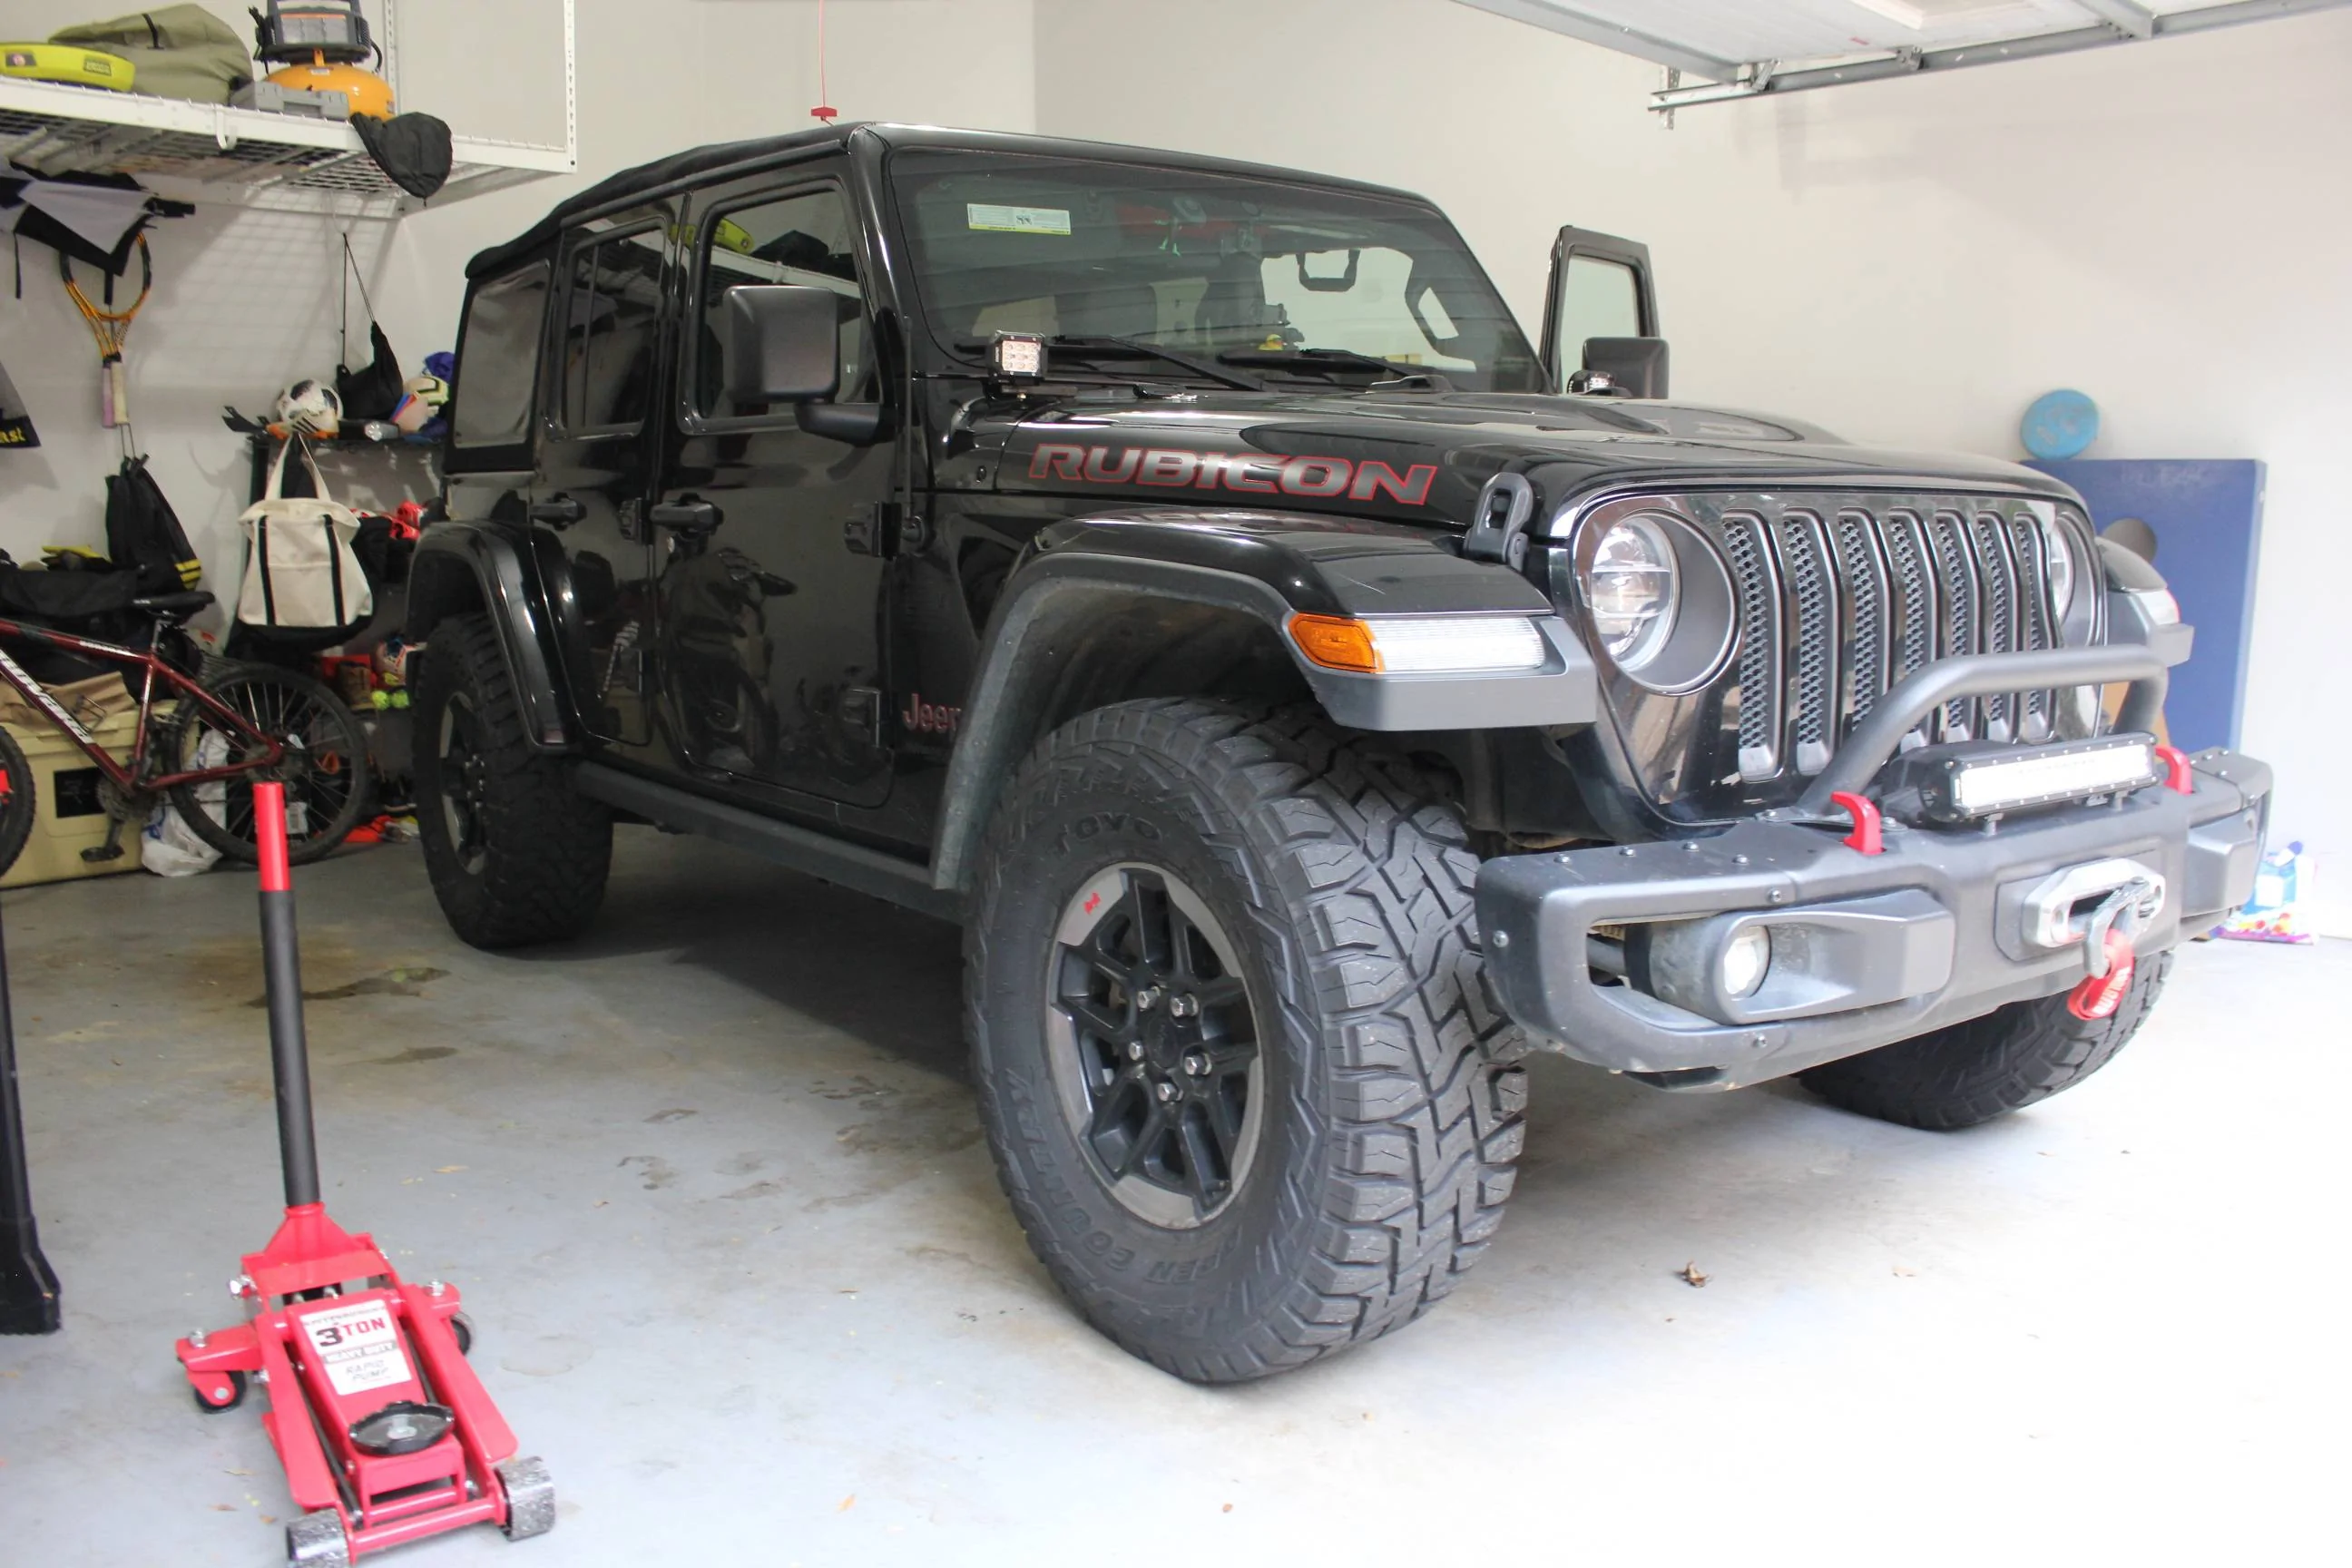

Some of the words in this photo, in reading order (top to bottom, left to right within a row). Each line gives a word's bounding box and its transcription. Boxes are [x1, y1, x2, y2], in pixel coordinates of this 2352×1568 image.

[1027, 443, 1438, 505] RUBICON
[315, 1326, 343, 1348] 3
[343, 1317, 386, 1337] TON
